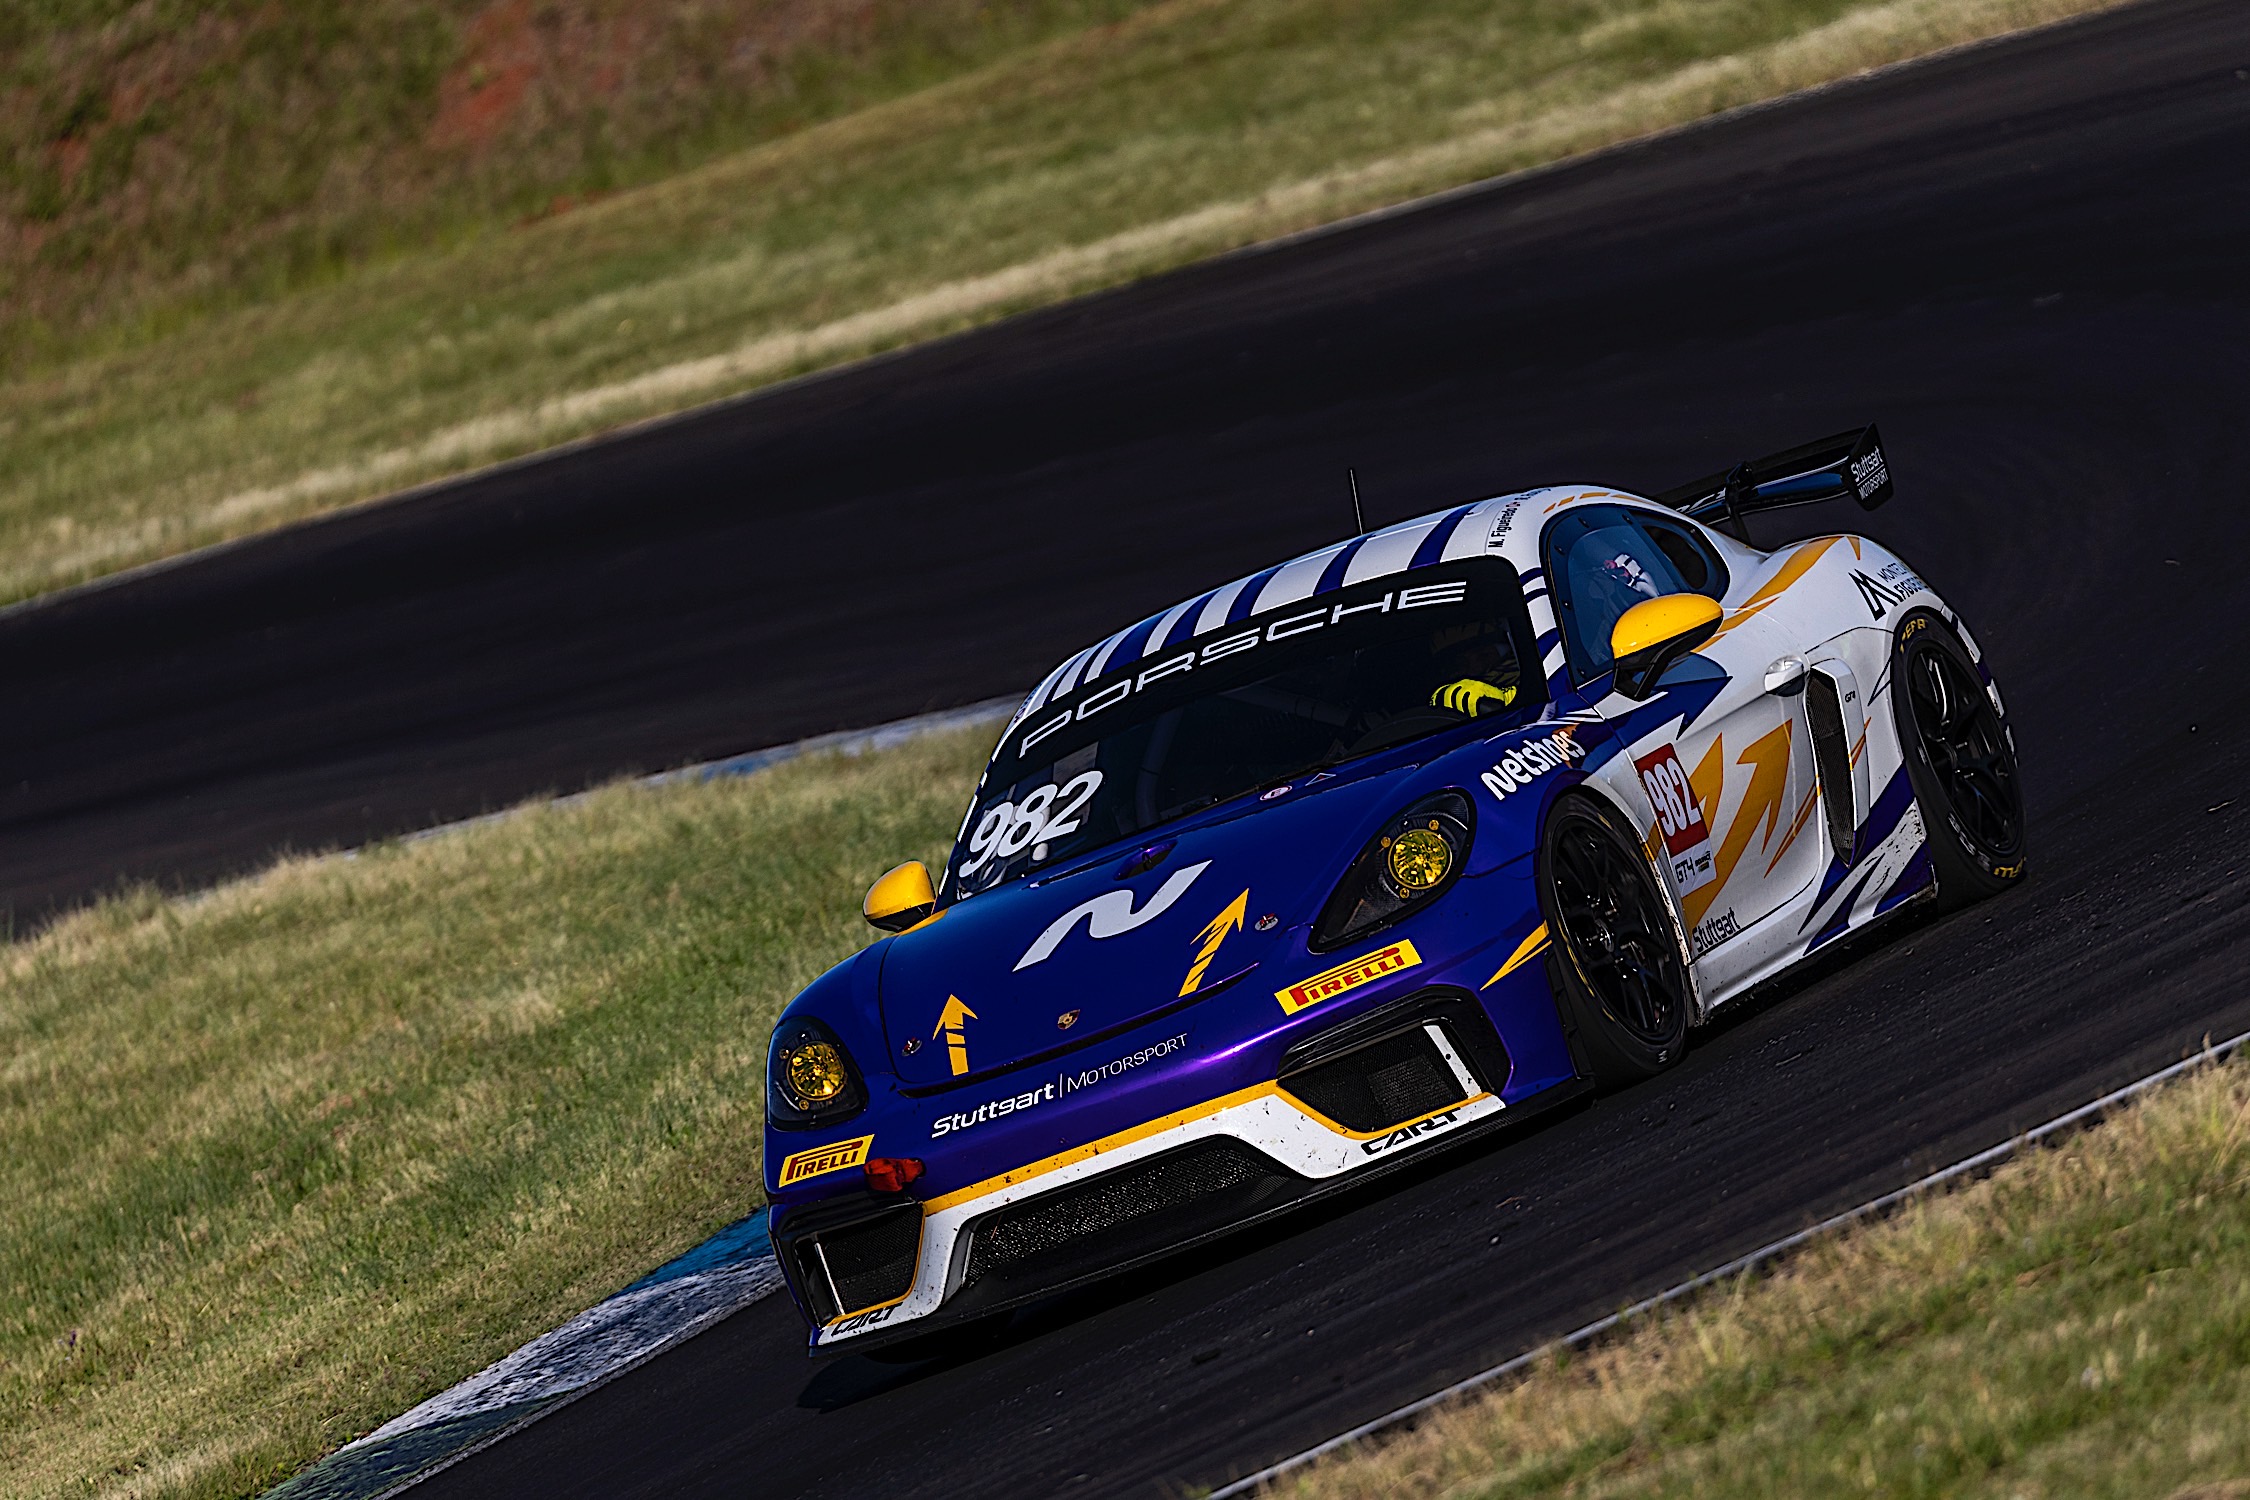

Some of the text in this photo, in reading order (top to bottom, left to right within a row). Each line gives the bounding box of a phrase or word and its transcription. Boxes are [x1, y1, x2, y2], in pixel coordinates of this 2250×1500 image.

[1019, 580, 1467, 759] PORSCHE
[1481, 730, 1586, 800] Netshoes
[958, 770, 1104, 878] 982
[1643, 757, 1702, 837] 982
[1675, 857, 1696, 884] GT4
[1692, 906, 1741, 953] Stuttgart
[1288, 946, 1405, 1007] PIRELLI
[931, 1083, 1055, 1139] Stuttgart
[785, 1140, 863, 1181] PIRELLI
